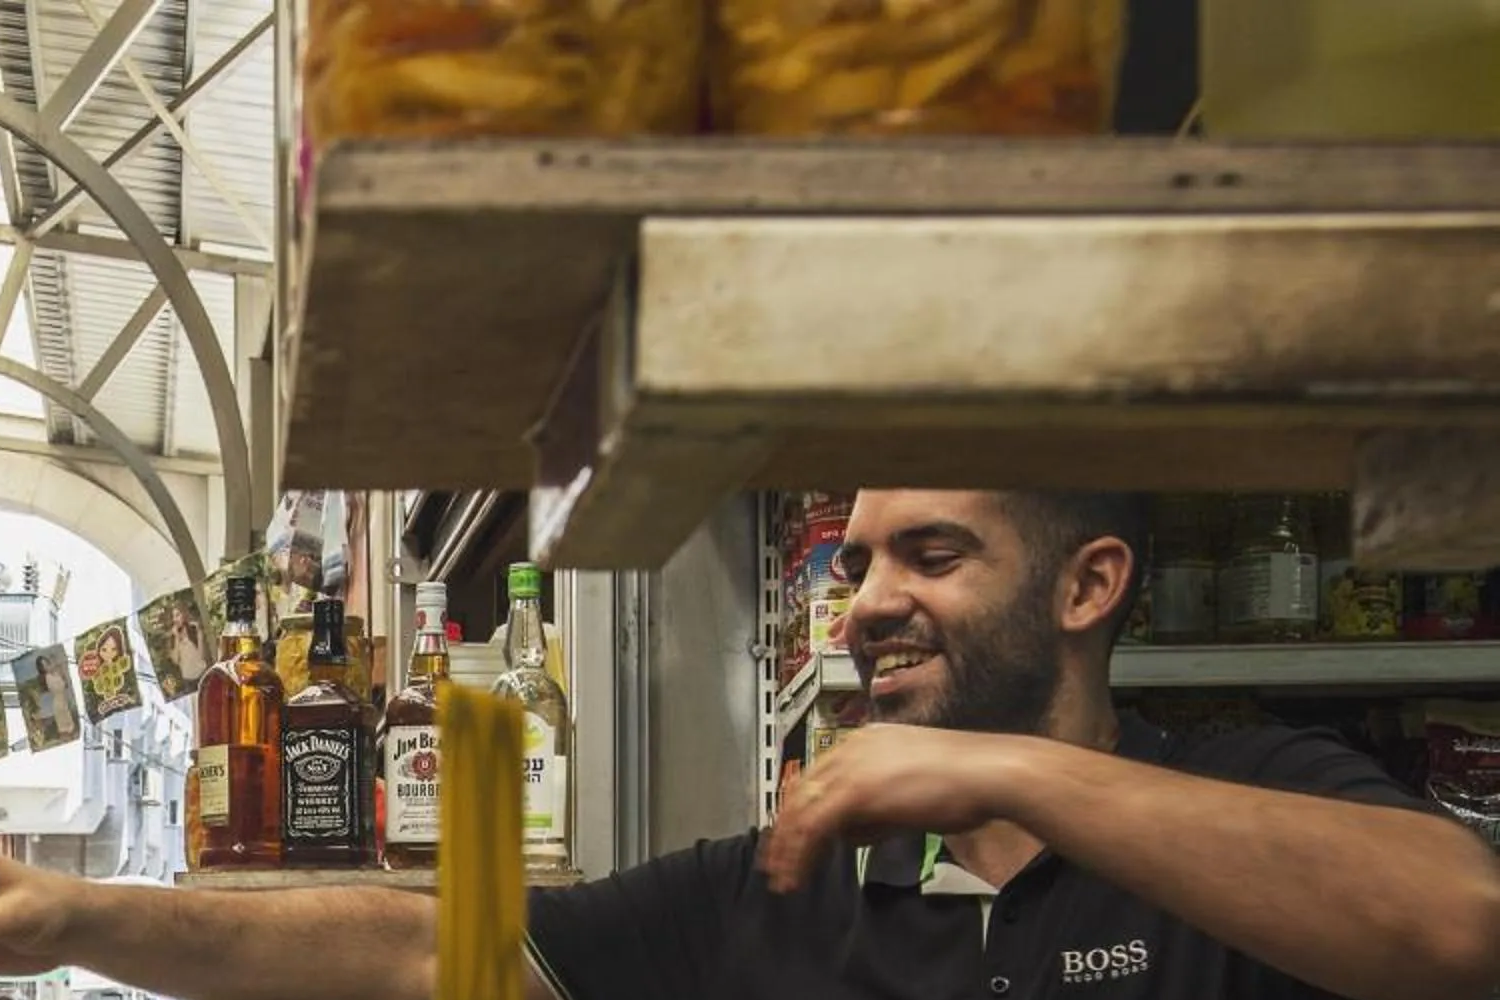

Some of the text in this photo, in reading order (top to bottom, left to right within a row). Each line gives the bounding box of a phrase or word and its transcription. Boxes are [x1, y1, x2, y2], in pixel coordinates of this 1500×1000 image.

[285, 735, 352, 762] JACK DANIEL'S
[393, 731, 442, 761] JIM BE
[397, 783, 440, 797] BOURB
[1061, 939, 1149, 974] BOSS
[1110, 961, 1149, 978] BOSS
